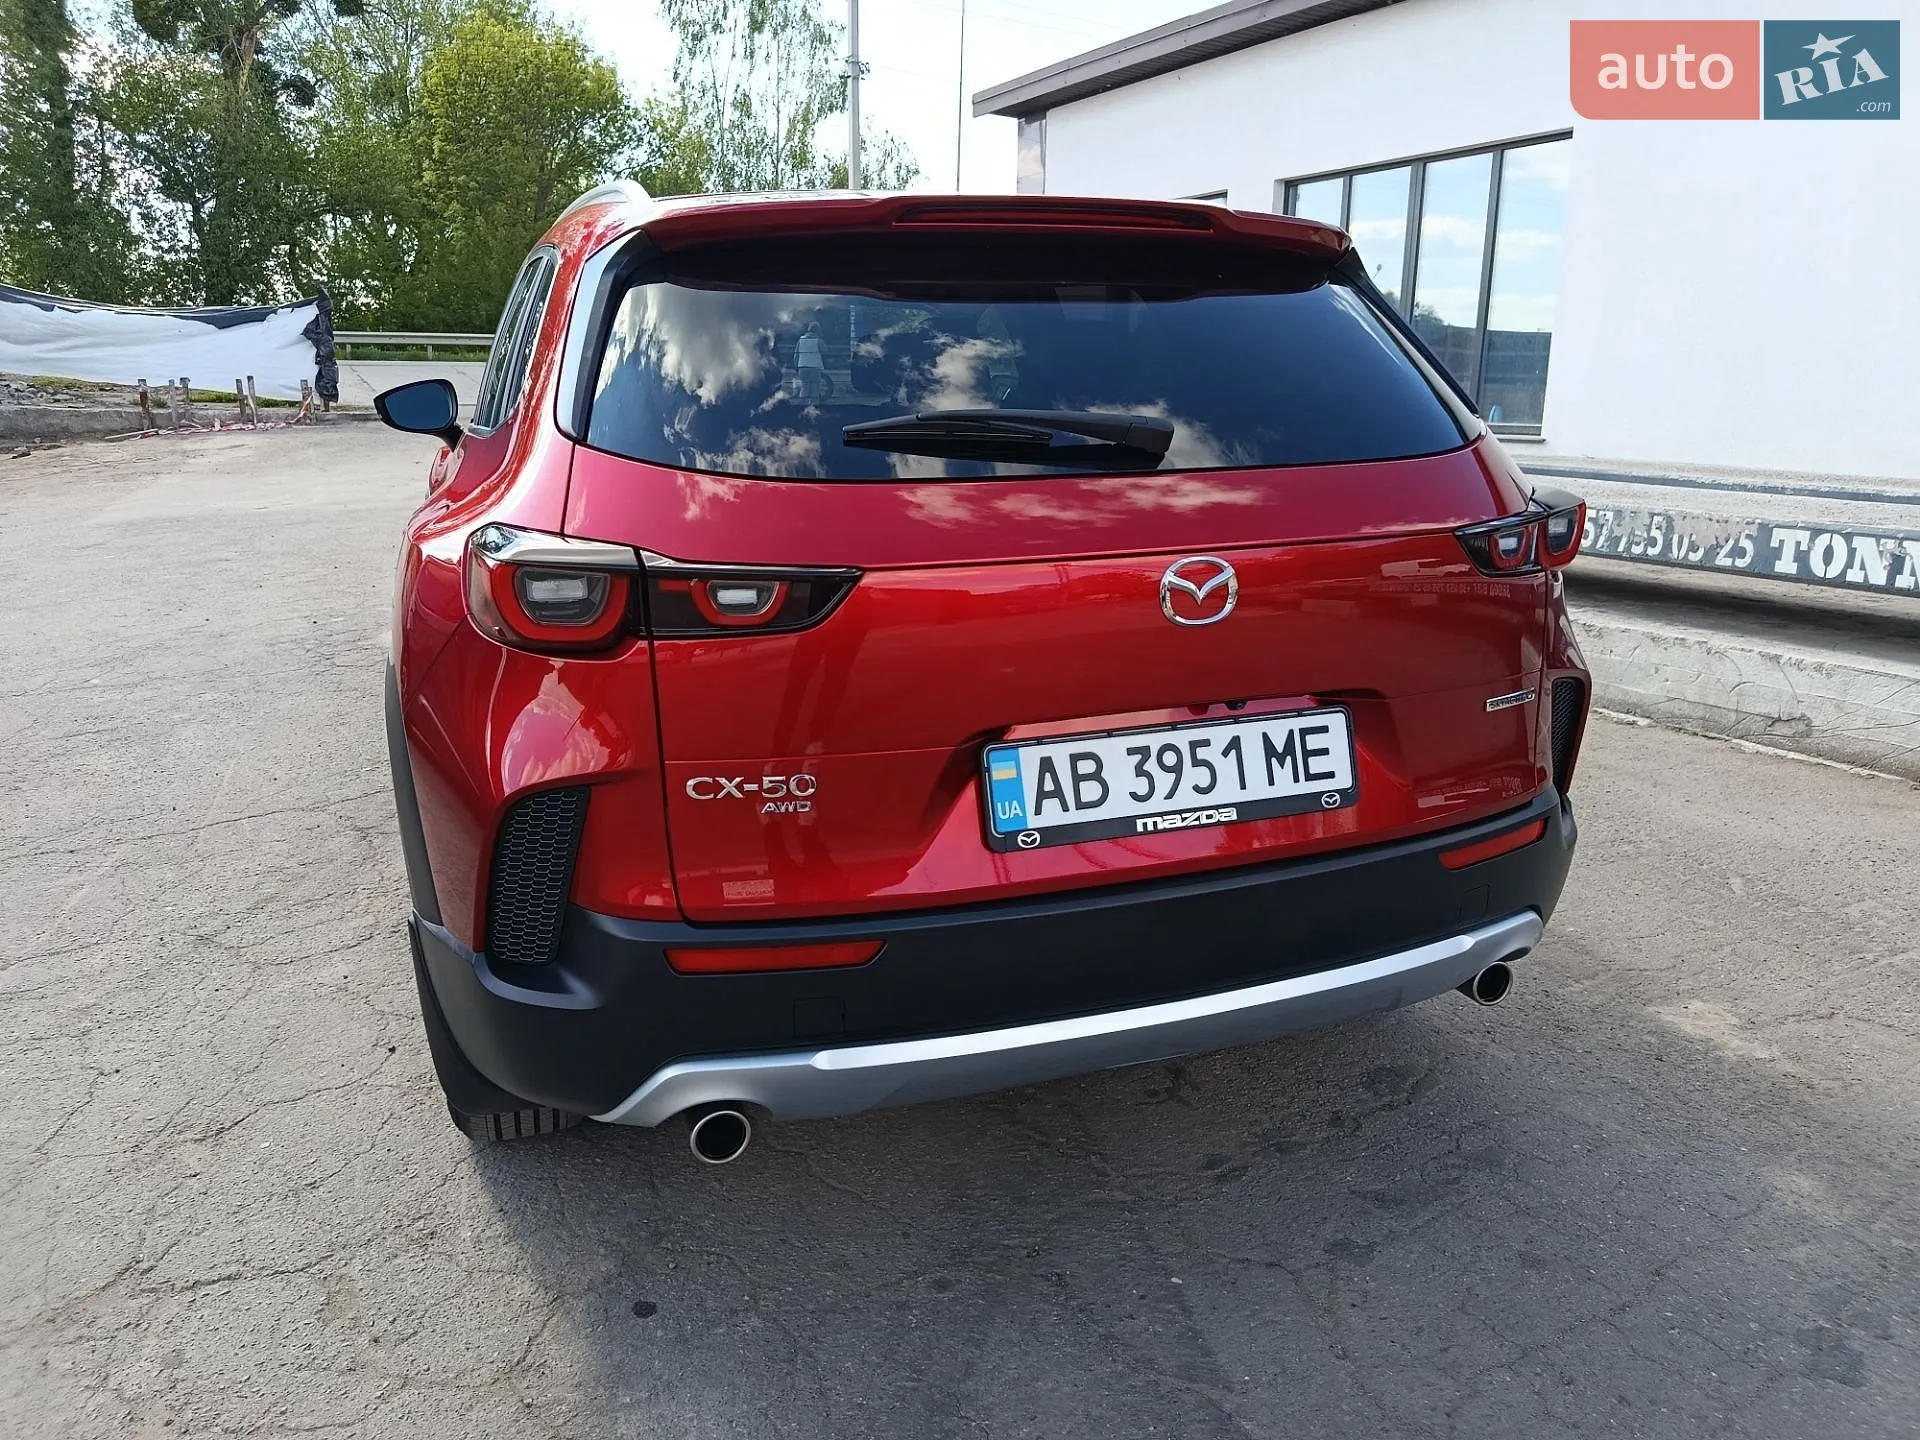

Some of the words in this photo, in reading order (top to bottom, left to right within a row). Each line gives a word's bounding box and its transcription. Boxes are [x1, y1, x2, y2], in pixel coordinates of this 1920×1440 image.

[1033, 751, 1110, 816] AB
[1126, 735, 1247, 802] 3951
[1261, 725, 1336, 787] ME
[685, 774, 817, 800] CX-50
[760, 801, 812, 814] AWD
[998, 801, 1023, 820] UA
